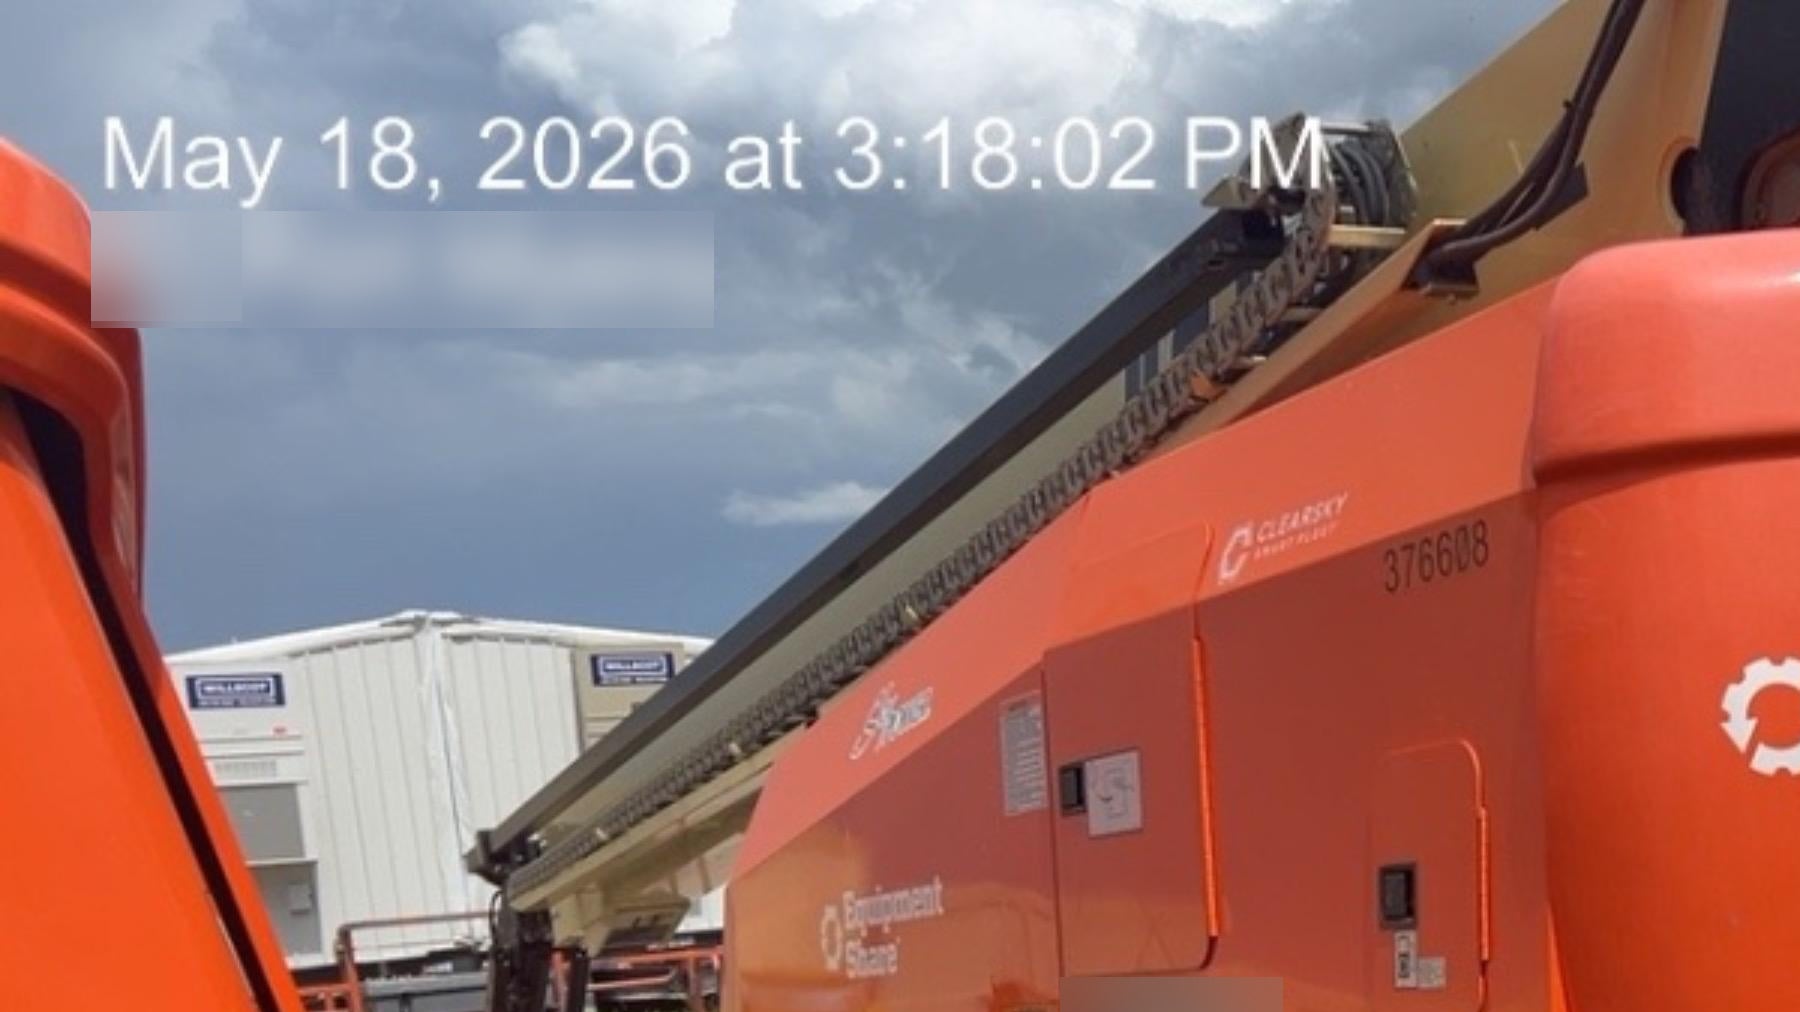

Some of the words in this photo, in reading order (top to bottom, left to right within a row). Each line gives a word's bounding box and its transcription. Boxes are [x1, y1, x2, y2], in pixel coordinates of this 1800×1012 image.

[1255, 490, 1349, 543] CLEARSKY
[1383, 517, 1490, 595] 376608
[842, 873, 944, 938] Equipment
[845, 939, 898, 979] Share
